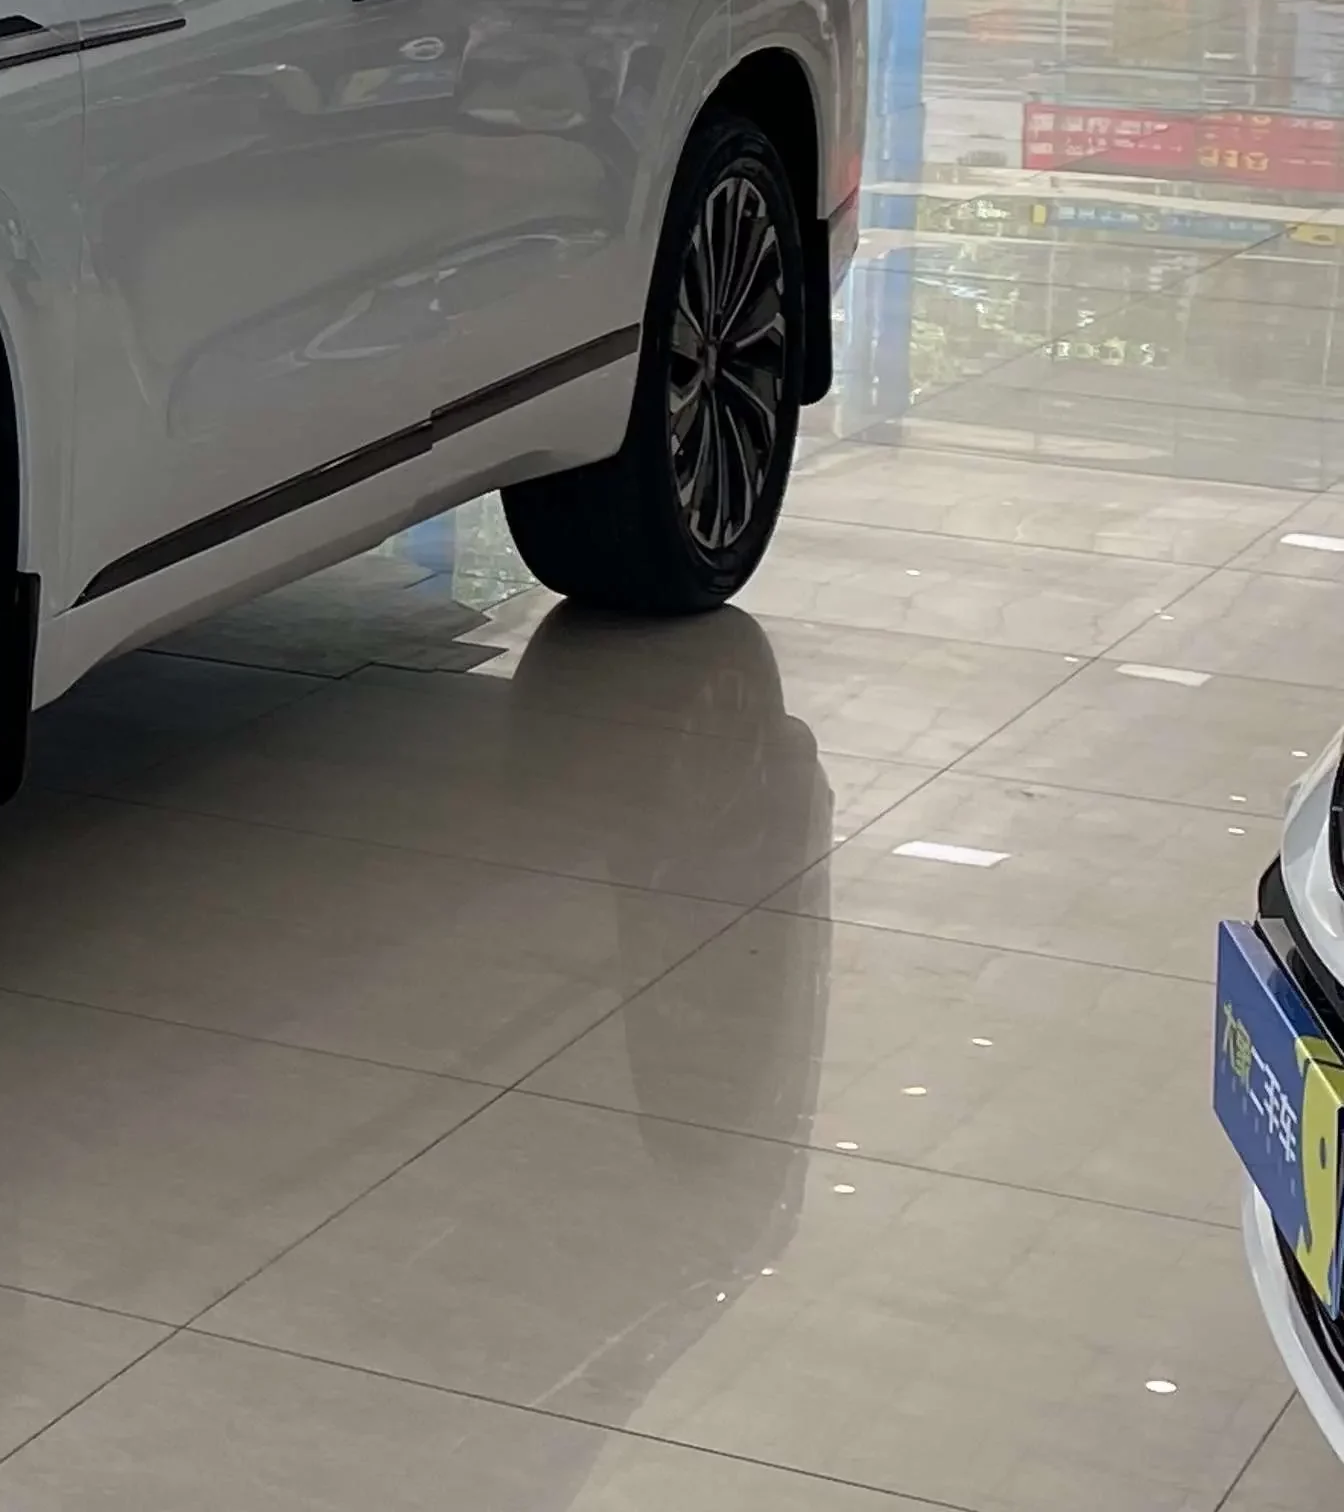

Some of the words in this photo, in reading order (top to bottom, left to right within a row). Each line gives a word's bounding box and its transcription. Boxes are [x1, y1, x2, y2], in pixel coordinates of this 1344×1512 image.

[1223, 1000, 1297, 1162] 大象二手车
